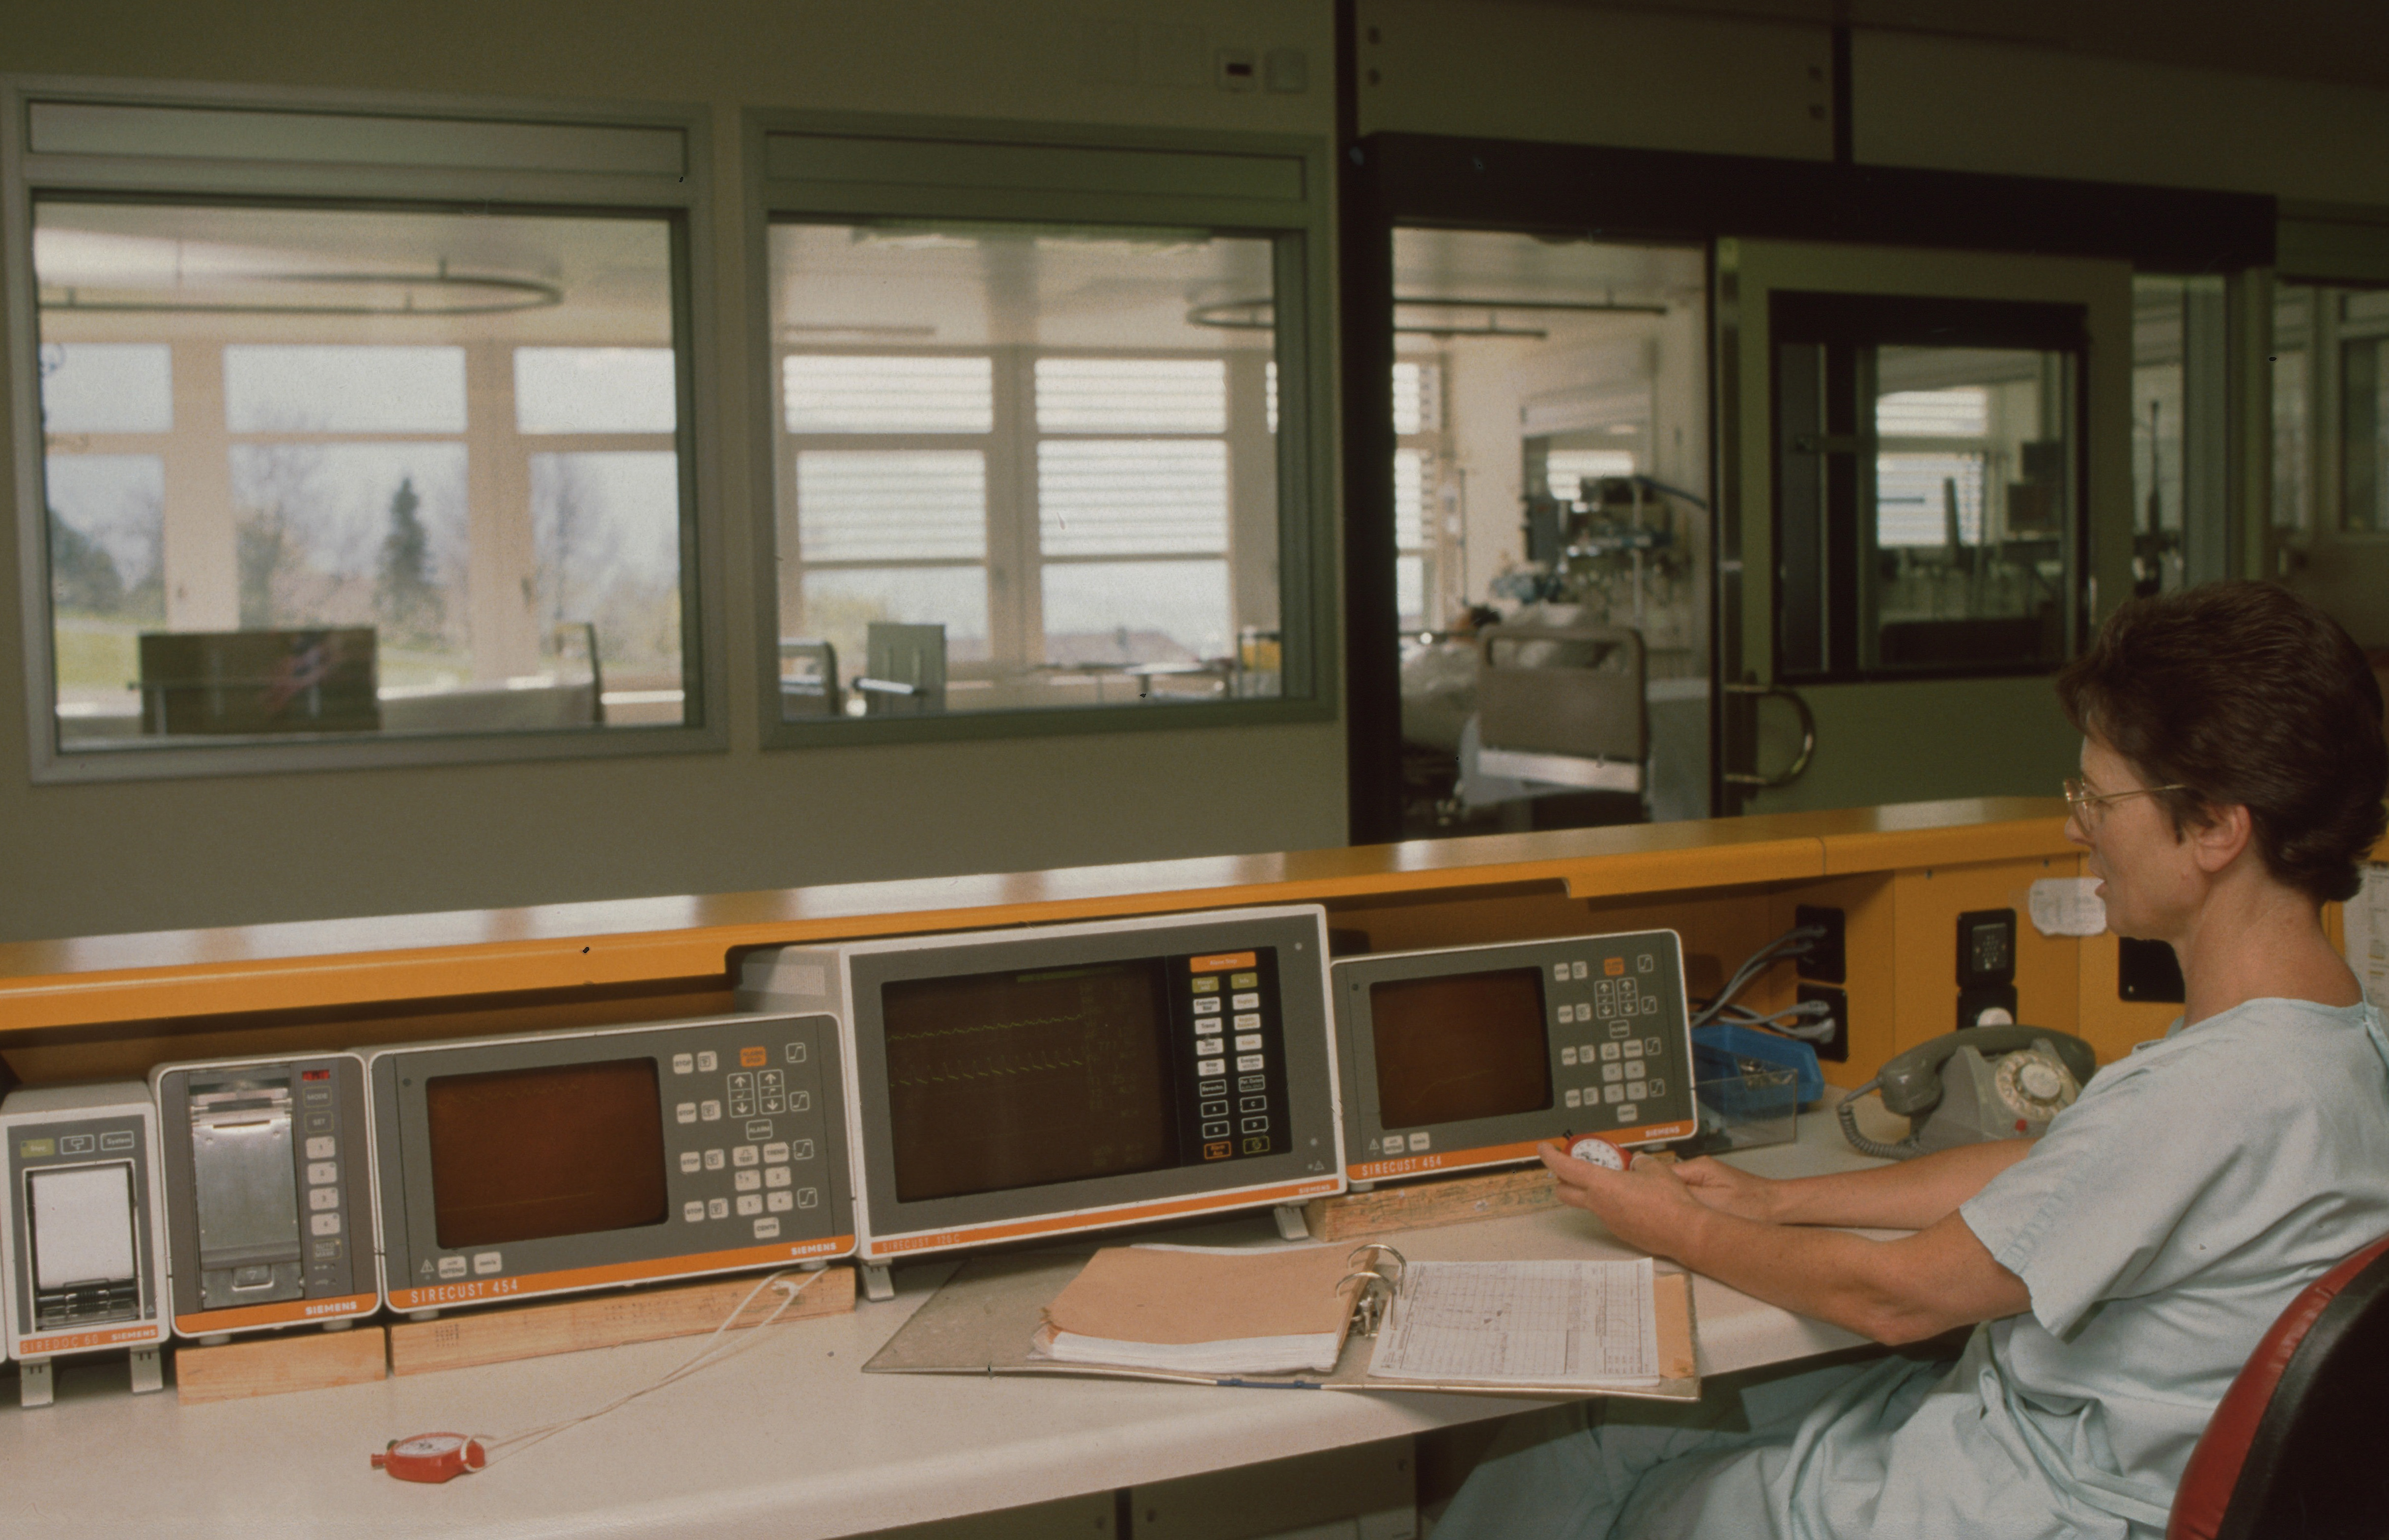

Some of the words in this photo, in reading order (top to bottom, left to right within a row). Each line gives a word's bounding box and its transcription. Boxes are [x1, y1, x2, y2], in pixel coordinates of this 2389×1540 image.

[1645, 1125, 1680, 1138] SIEMENS
[1362, 1158, 1416, 1177] SIRECUST
[1423, 1155, 1442, 1168] 454
[791, 1242, 836, 1256] SIEMENS
[882, 1236, 929, 1252] SIRECUST
[411, 1282, 483, 1304] SIRECUST
[492, 1278, 518, 1293] 454
[305, 1300, 357, 1316] SIEMENS
[84, 1334, 99, 1344] 60
[111, 1328, 156, 1342] SIEMENS
